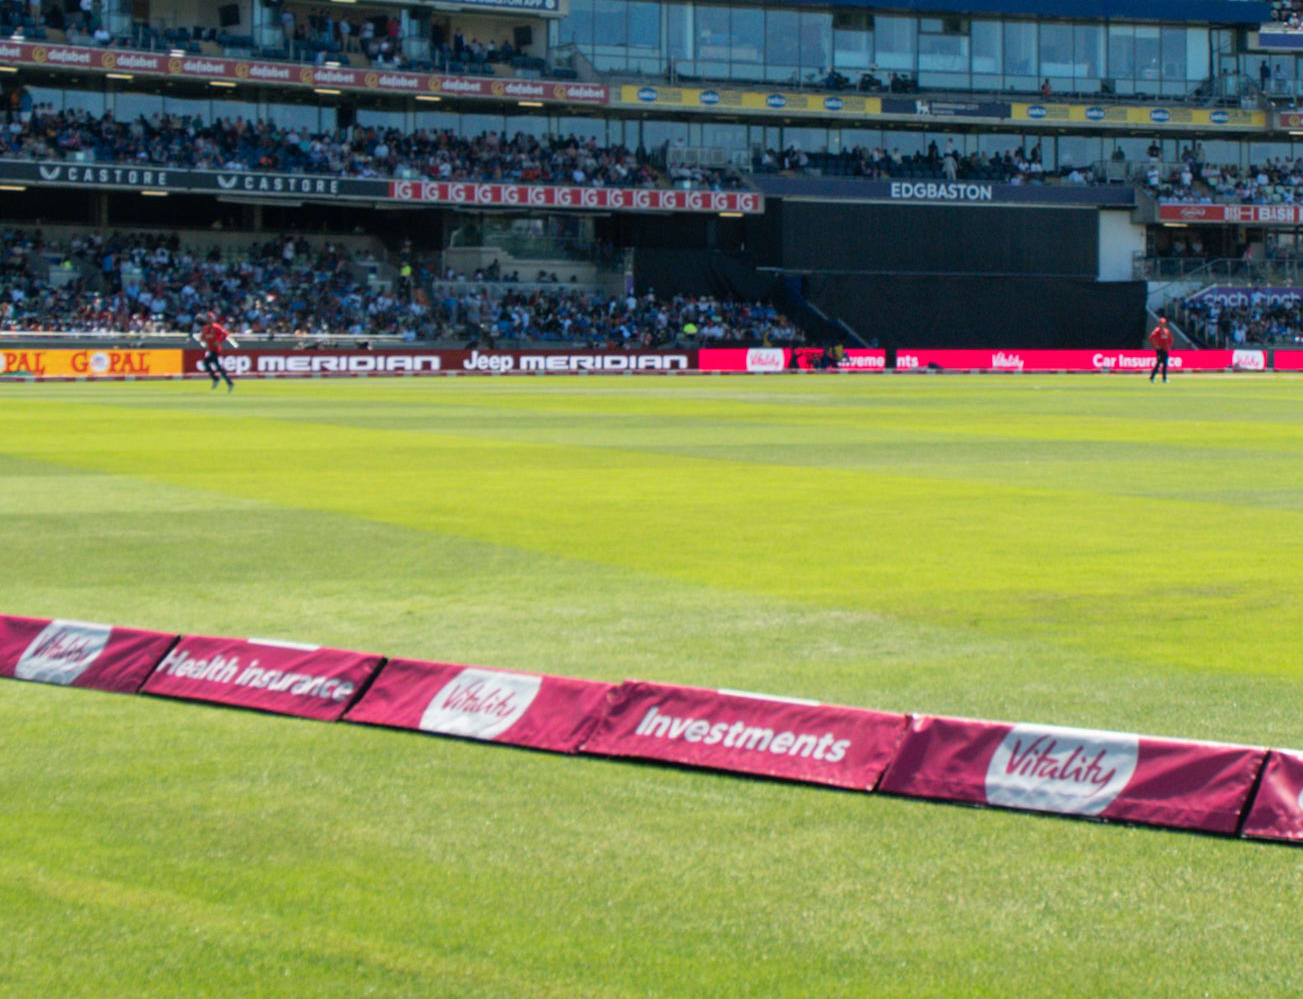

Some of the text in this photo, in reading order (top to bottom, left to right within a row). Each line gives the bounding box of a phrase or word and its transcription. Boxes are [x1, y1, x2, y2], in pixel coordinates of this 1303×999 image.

[48, 49, 90, 64] dafabet
[117, 55, 157, 69] dafabet
[183, 60, 224, 74] dafabet
[250, 65, 290, 80] dafabet
[314, 69, 354, 84] dafabet
[379, 73, 418, 88] dafabet
[442, 79, 481, 93] dafabet
[505, 81, 543, 96] dafabet
[567, 85, 604, 99] dafabet
[68, 169, 167, 186] CASTORE
[244, 178, 339, 194] CASTORE
[890, 182, 992, 200] EDGBASTON
[1224, 206, 1254, 220] BISH
[1258, 207, 1295, 221] BASH
[257, 355, 441, 371] MERIDIAN
[463, 350, 688, 372] Jeep MERIDIAN
[992, 351, 1024, 370] Vitality
[1092, 354, 1182, 368] Car Insurace
[155, 648, 356, 702] Health insurance
[440, 677, 517, 720] Vitality
[635, 705, 851, 763] Investments
[1005, 733, 1117, 792] Vitality
